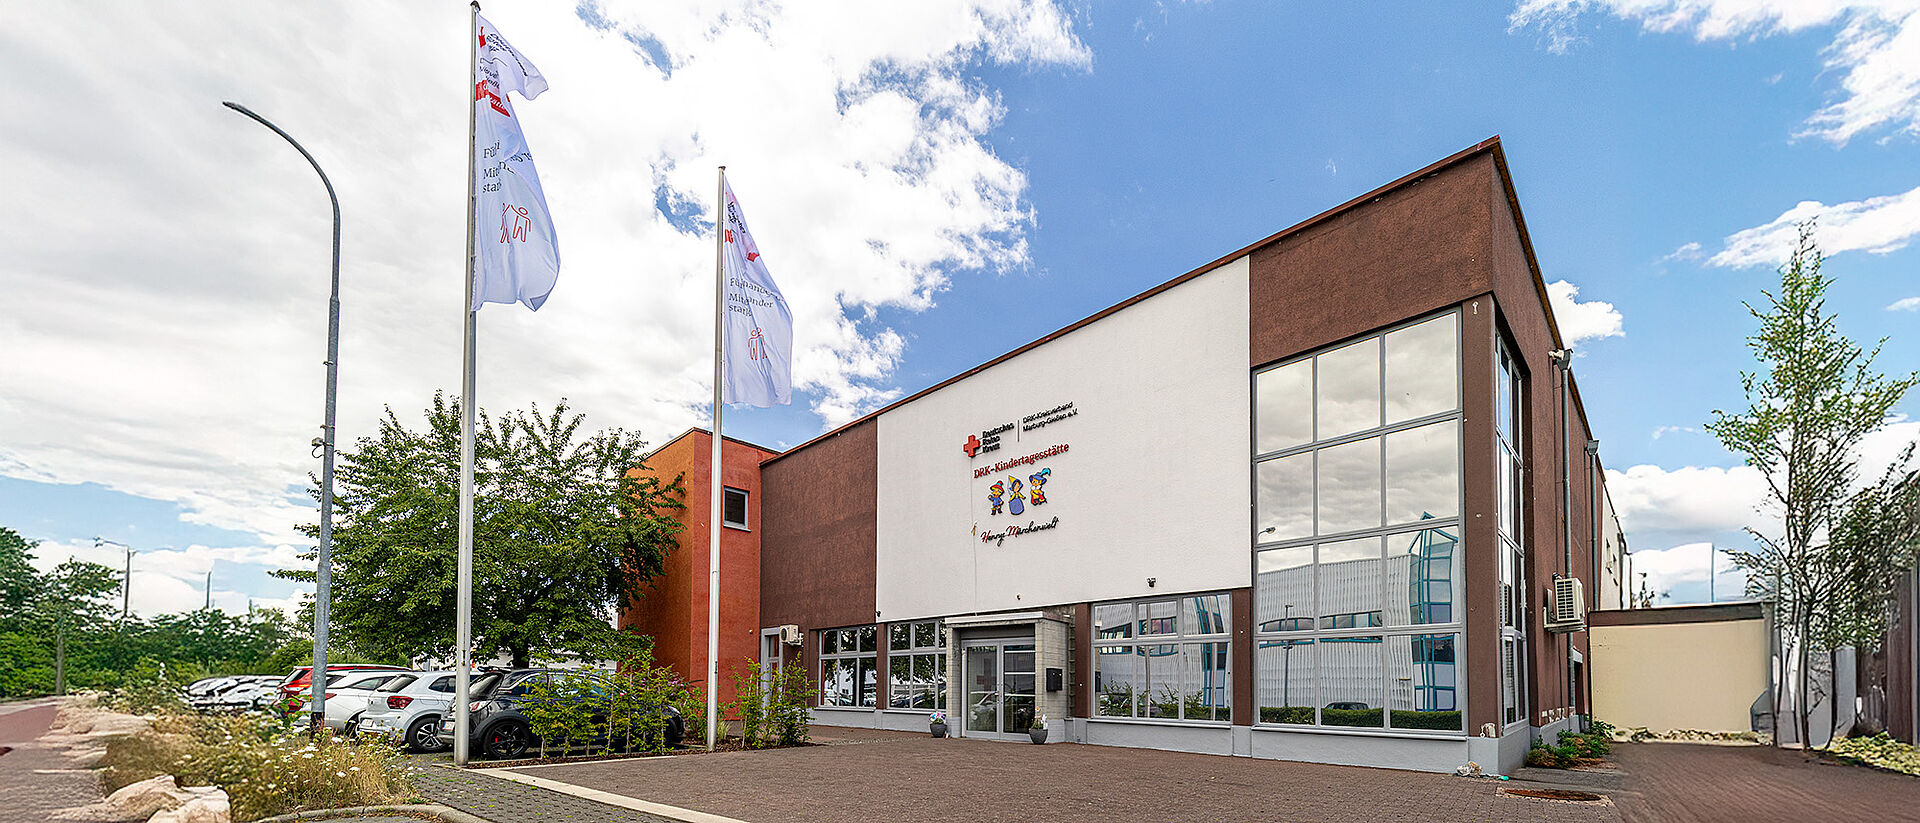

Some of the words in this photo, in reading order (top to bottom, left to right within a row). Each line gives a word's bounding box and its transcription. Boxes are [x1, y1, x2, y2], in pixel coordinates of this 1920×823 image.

[982, 422, 1014, 438] Deutsches
[982, 435, 1000, 445] Rotes
[982, 443, 1000, 453] Kreuz
[973, 443, 1070, 478] DRK-Kindertagesstätte
